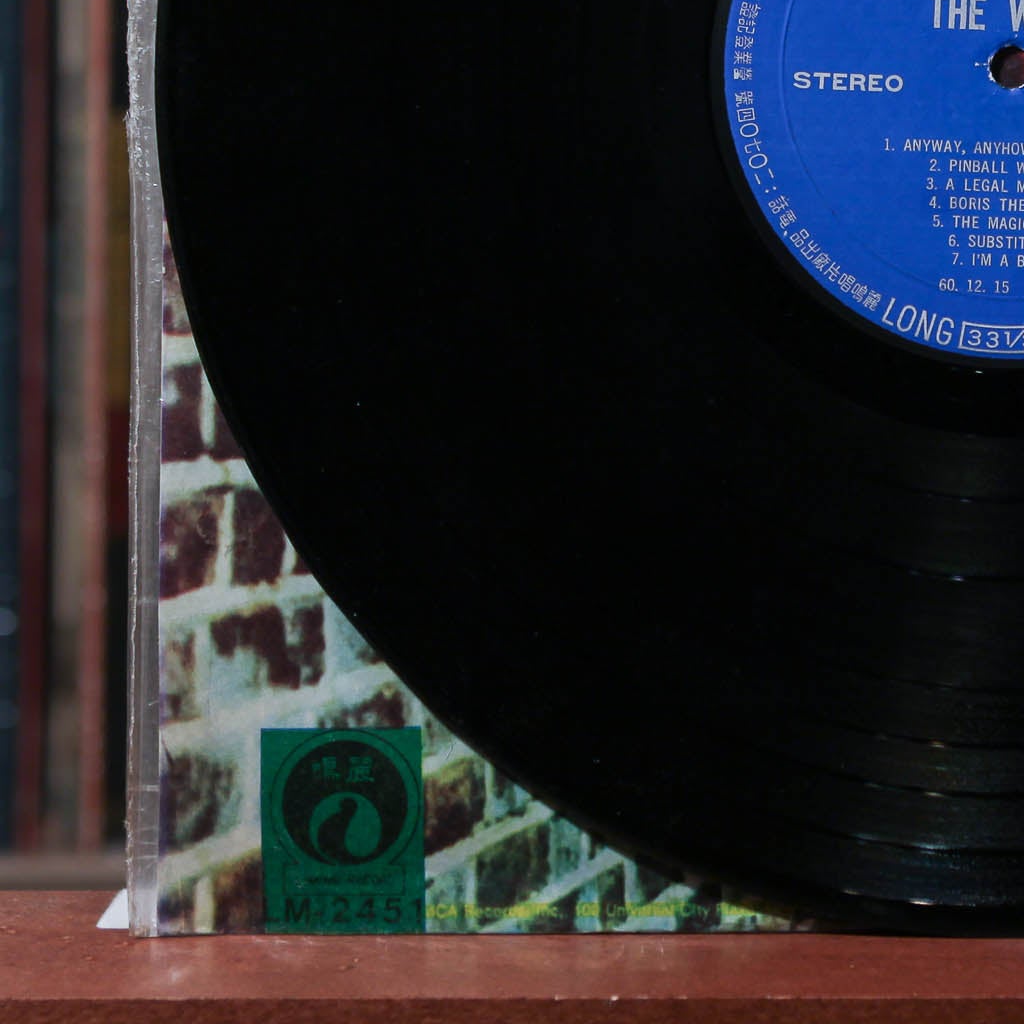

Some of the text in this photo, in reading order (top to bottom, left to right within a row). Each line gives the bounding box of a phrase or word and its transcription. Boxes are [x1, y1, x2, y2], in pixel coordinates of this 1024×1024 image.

[793, 71, 904, 93] STEREO
[903, 138, 966, 155] ANYWAY,
[929, 158, 941, 172] 2.
[949, 159, 1008, 174] PINBALL
[925, 177, 938, 192] 3.
[945, 177, 955, 191] A
[964, 178, 1009, 193] LEGAL
[928, 196, 941, 209] 4.
[949, 196, 990, 211] BORIS
[932, 214, 944, 228] 5.
[952, 215, 980, 229] THE
[948, 234, 960, 247] 6.
[951, 252, 964, 267] 7.
[972, 253, 992, 267] I'M
[999, 254, 1009, 267] A
[995, 280, 1010, 294] 15
[881, 297, 955, 346] LONG
